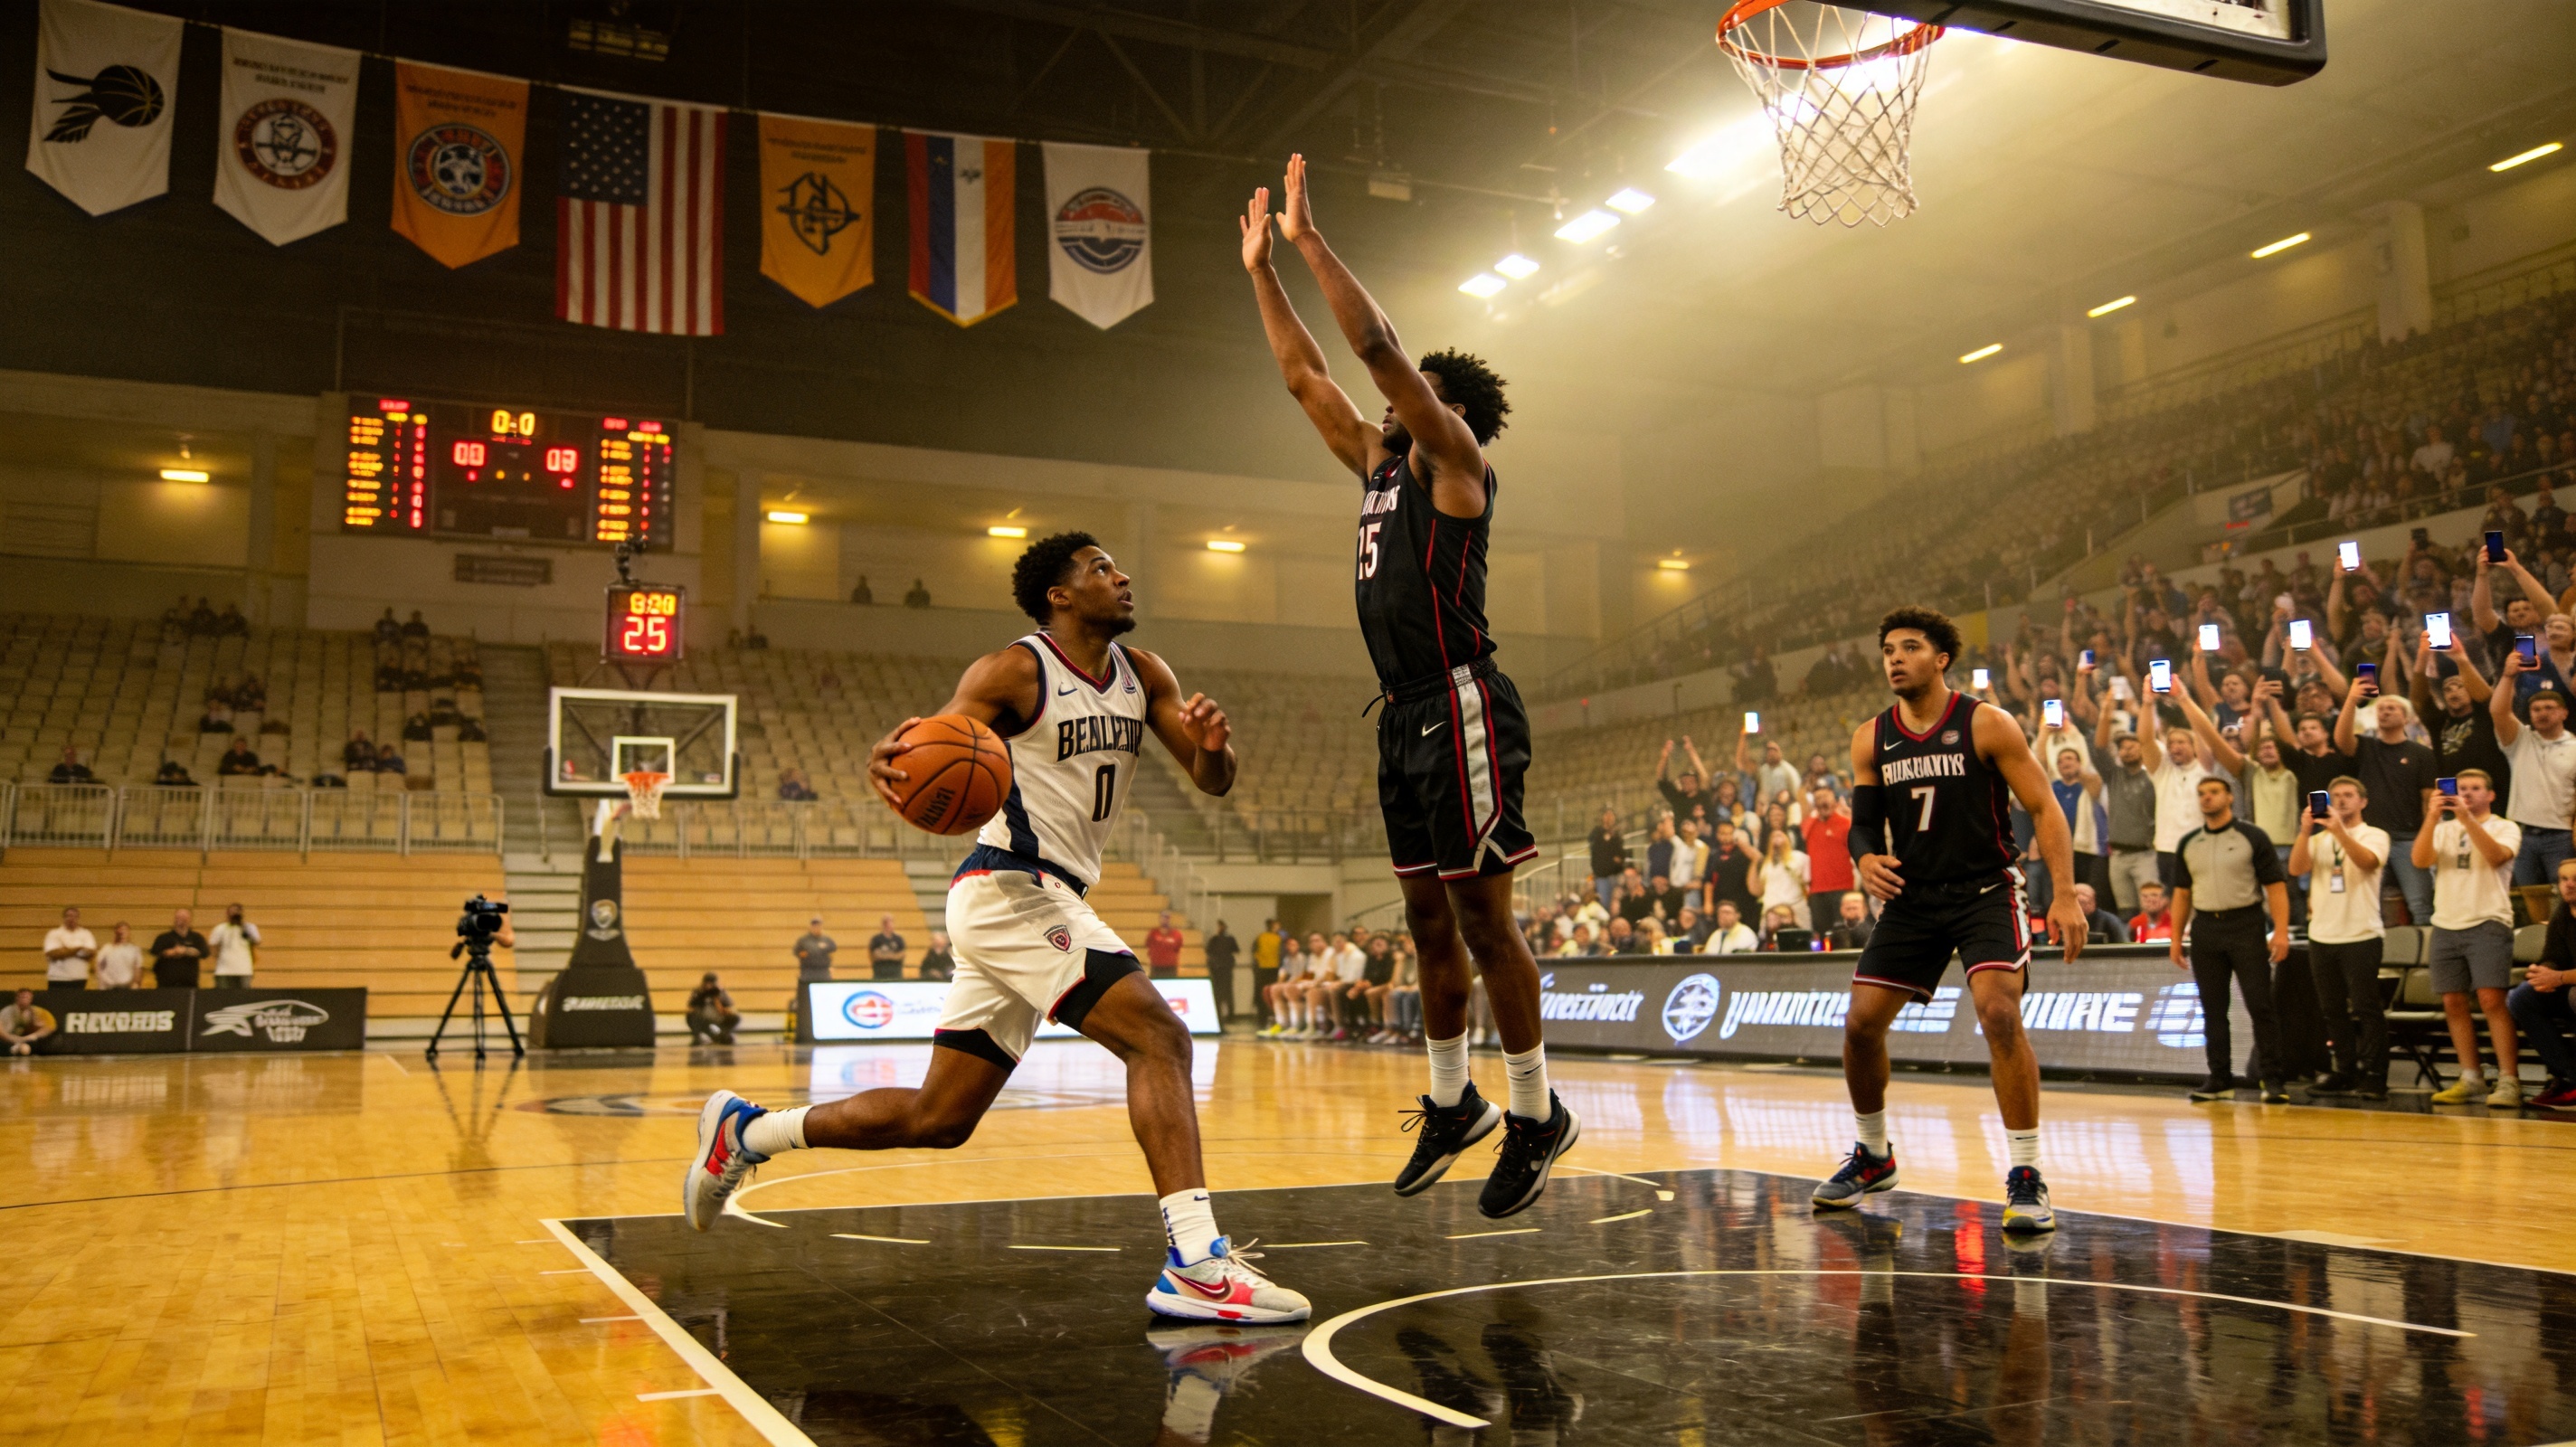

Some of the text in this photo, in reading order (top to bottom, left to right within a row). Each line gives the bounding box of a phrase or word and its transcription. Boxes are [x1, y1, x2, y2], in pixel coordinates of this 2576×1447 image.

[625, 616, 666, 651] 25
[1092, 763, 1115, 822] 0
[1910, 785, 1936, 832] 7
